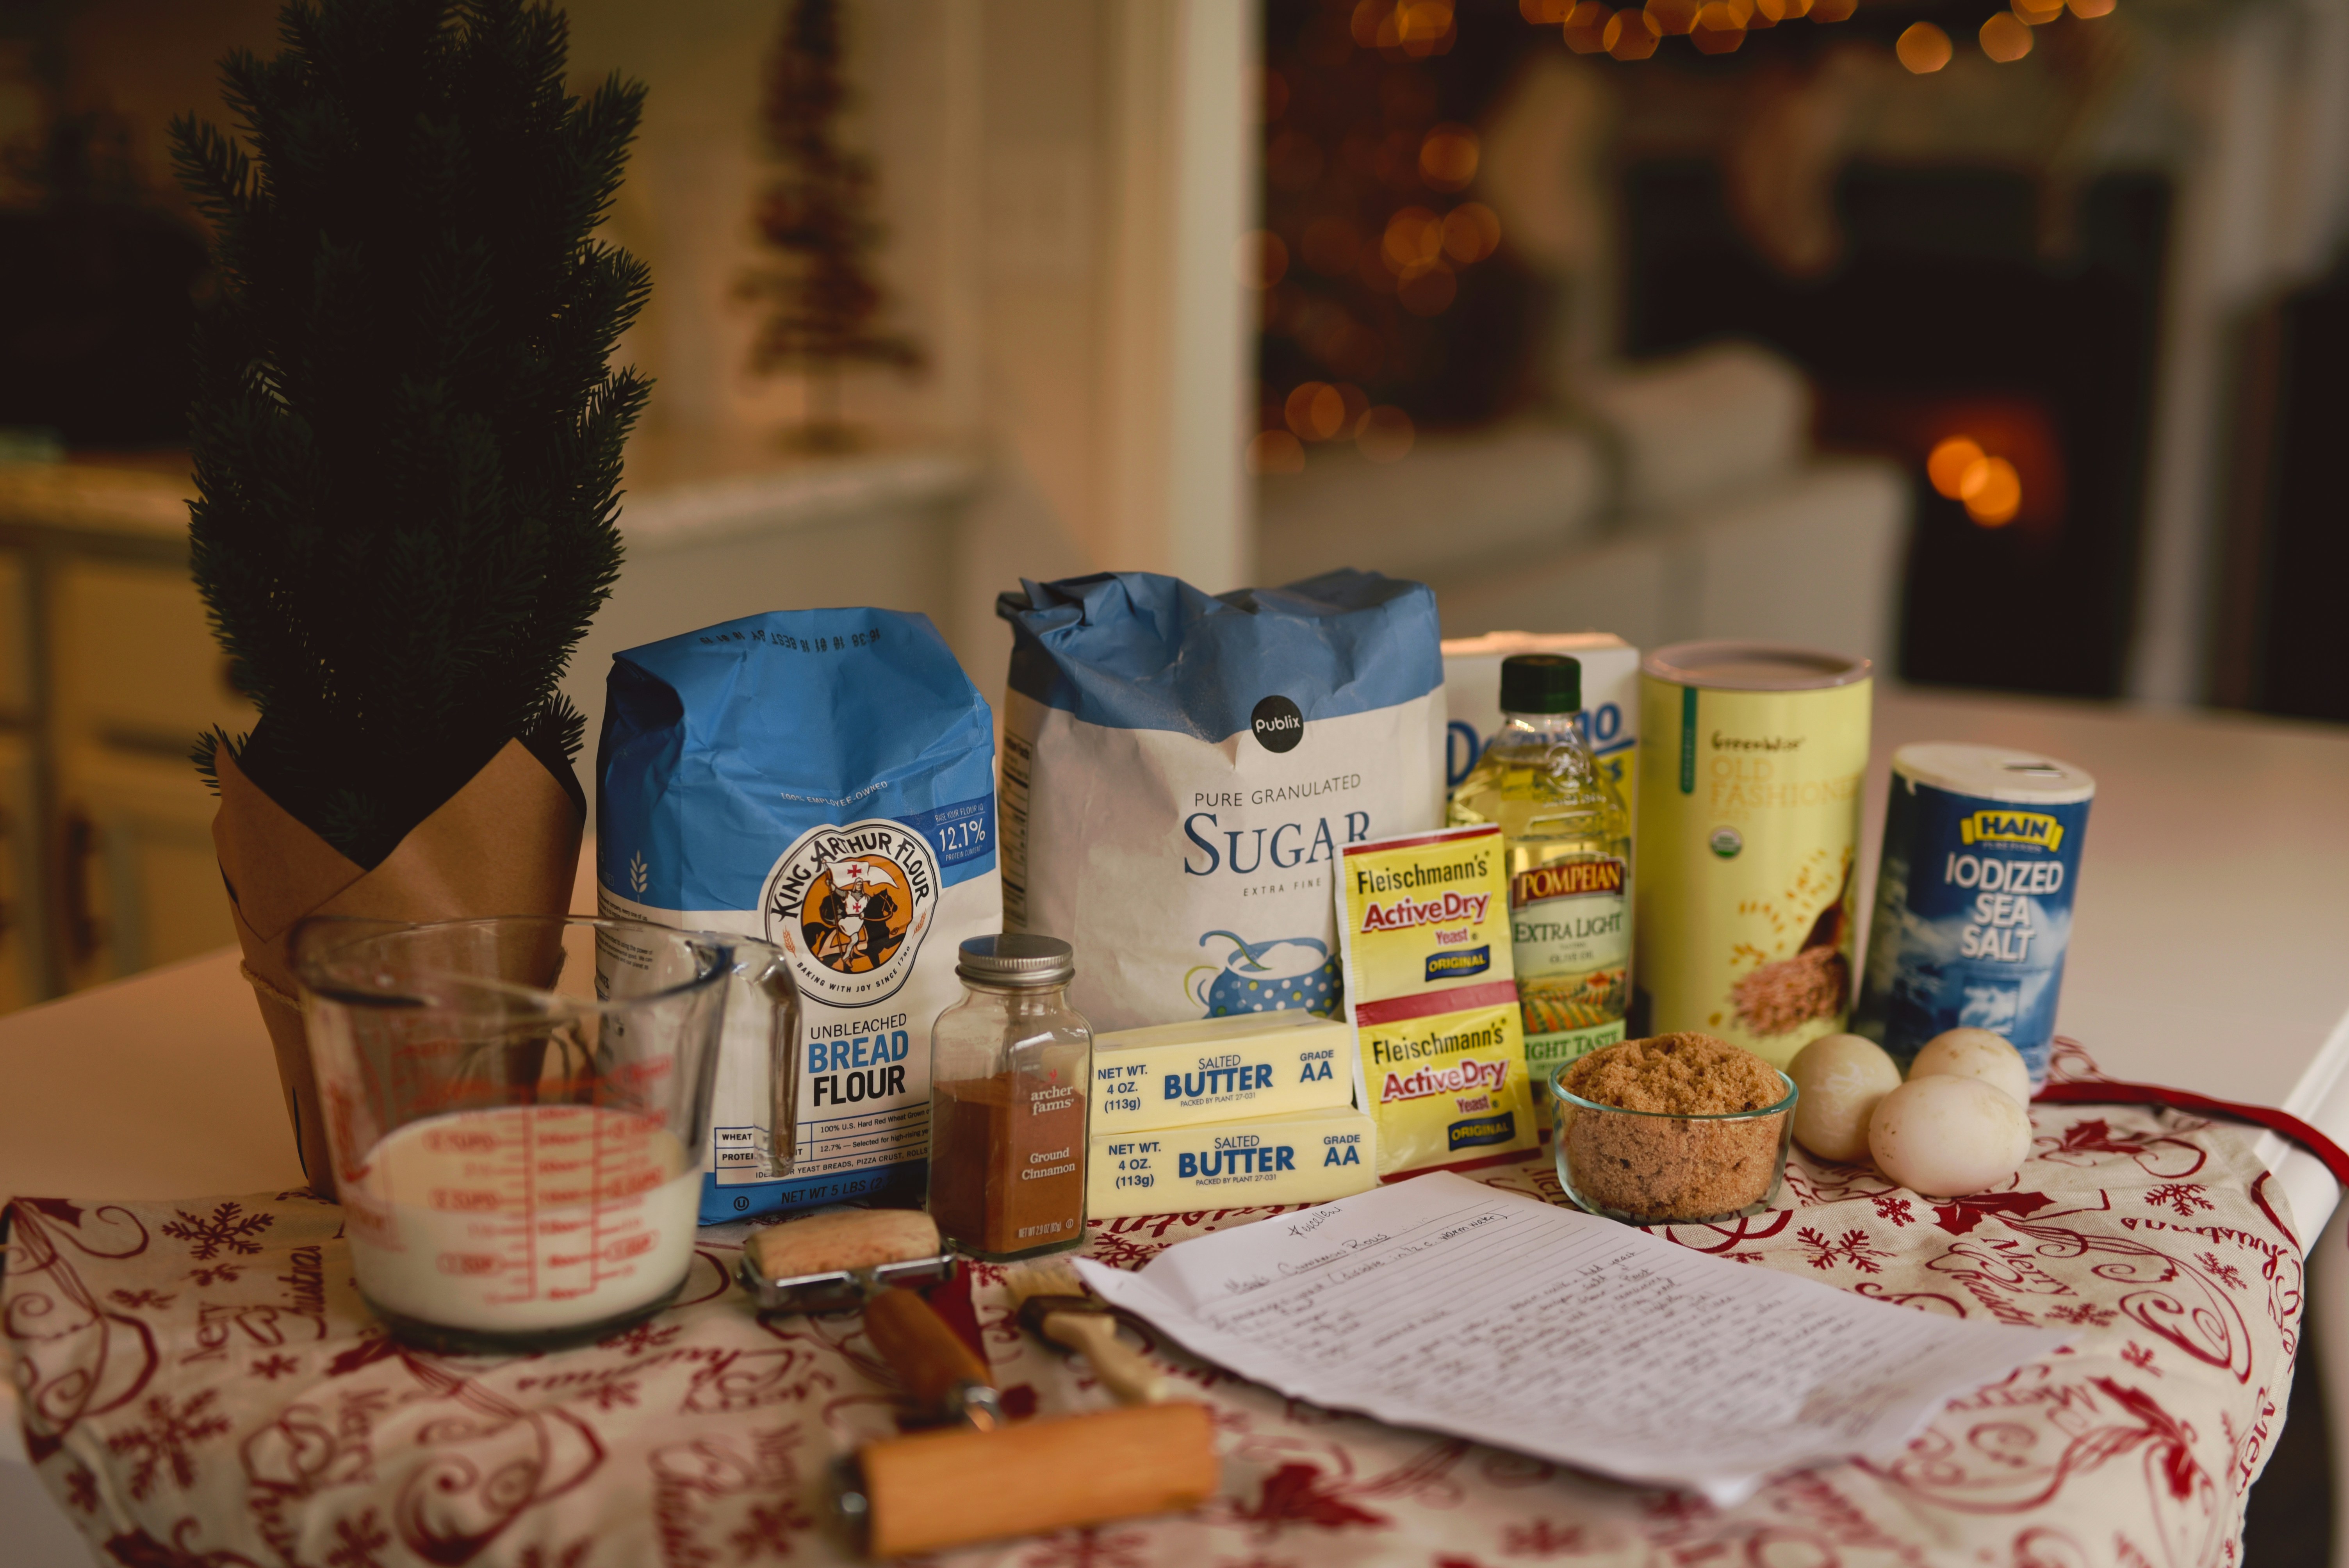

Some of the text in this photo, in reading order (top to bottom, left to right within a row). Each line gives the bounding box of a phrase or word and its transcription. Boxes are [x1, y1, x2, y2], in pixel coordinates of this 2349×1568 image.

[1256, 715, 1300, 733] Publix
[1709, 755, 1775, 781] OLD
[781, 781, 888, 807] 100% EMPLOYEE-OWNED
[1195, 773, 1361, 807] PURE GRANULATED
[935, 803, 983, 822] RAISE YOUR FLOUR IQ
[939, 818, 986, 852] 12.7%
[1982, 816, 2048, 838] HAIN
[1184, 811, 1370, 876] SUGAR
[946, 852, 964, 861] PROTEIN
[770, 832, 929, 922] KING ARTHUR FLOUR
[1357, 854, 1488, 894] Fleischmann's
[1521, 862, 1620, 900] POMPEIAN
[1945, 851, 2064, 895] IODIZED
[1243, 877, 1321, 897] EXTRA FINE
[1974, 893, 2030, 927] SEA
[1435, 927, 1469, 946] Yeast
[1514, 911, 1622, 943] EXTRA LIGHT
[1961, 925, 2035, 962] SALT
[797, 946, 910, 992] BAKING WITH JOY SINCE 1790
[1428, 953, 1486, 972] ORIGINAL
[811, 1013, 907, 1039] UNBLEACHED
[808, 1030, 909, 1074] BREAD
[1372, 1022, 1504, 1065] Fleischmann's
[1525, 1039, 1570, 1061] IGHT
[1198, 1055, 1241, 1070] SALTED
[1300, 1049, 1334, 1061] GRADE
[1098, 1064, 1148, 1080] NET WT.
[1164, 1064, 1273, 1100] BUTTER
[1299, 1061, 1333, 1083] AA
[814, 1065, 906, 1107] FLOUR
[1030, 1085, 1073, 1101] archer
[1107, 1082, 1138, 1094] 4 OZ.
[1033, 1099, 1072, 1116] farms
[1105, 1097, 1141, 1114] (113g)
[1181, 1098, 1204, 1107] PACKED
[1215, 1095, 1233, 1103] PLANT
[1235, 1092, 1255, 1101] 27-031
[1456, 1094, 1491, 1114] Yeast
[821, 1125, 839, 1133] 100%
[858, 1120, 872, 1128] Hard
[888, 1113, 906, 1123] Wheat
[908, 1111, 925, 1119] Grown
[1451, 1121, 1509, 1141] ORIGINAL
[820, 1144, 841, 1152] 12.7%
[853, 1139, 879, 1148] Selected
[891, 1129, 921, 1142] high-rising
[1109, 1142, 1161, 1155] NET WT.
[1214, 1135, 1260, 1149] SALTED
[1324, 1135, 1360, 1145] GRADE
[798, 1165, 820, 1174] YEAST
[823, 1161, 854, 1171] BREADS,
[857, 1157, 877, 1166] PIZZA
[879, 1152, 904, 1162] CRUST,
[907, 1147, 928, 1157] ROLLS
[1030, 1147, 1069, 1164] Ground
[1119, 1158, 1151, 1171] 4 OZ.
[1179, 1146, 1296, 1178] BUTTER
[1324, 1145, 1360, 1167] AA
[1021, 1162, 1075, 1181] Cinnamon
[1116, 1174, 1154, 1189] (113g)
[781, 1190, 806, 1204] NET
[809, 1186, 827, 1199] WT
[831, 1185, 838, 1196] 5
[842, 1180, 866, 1194] LBS
[1980, 1238, 2079, 1296] Merry
